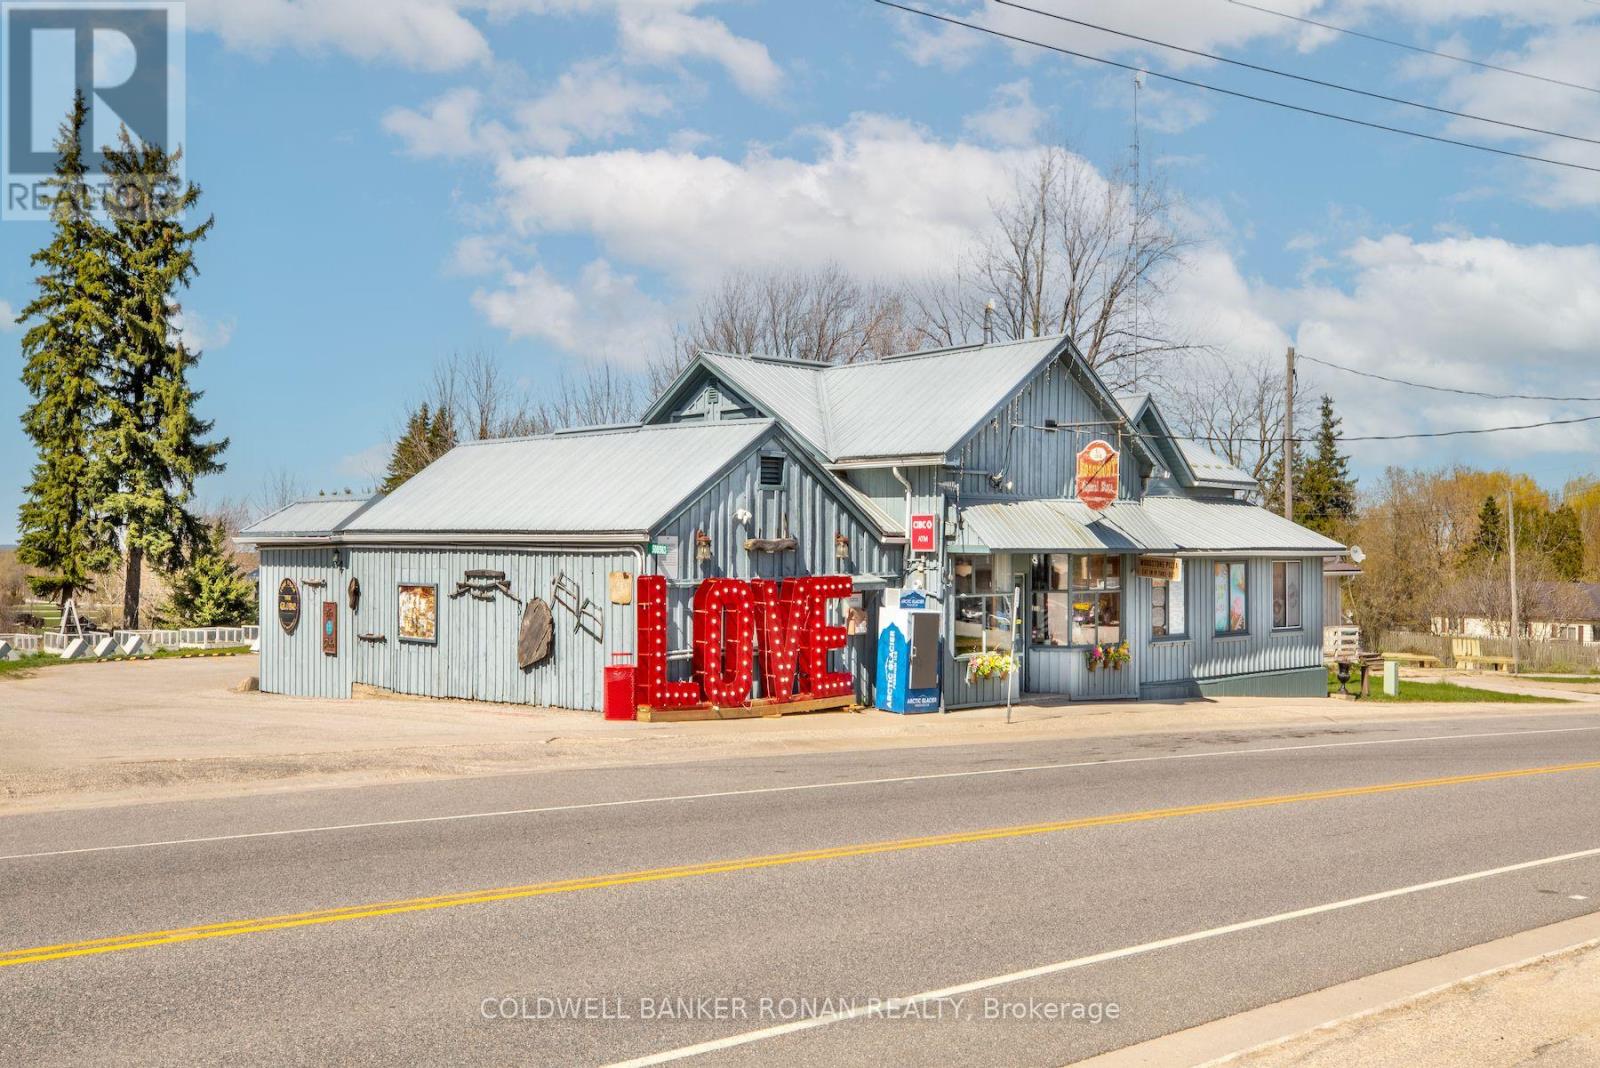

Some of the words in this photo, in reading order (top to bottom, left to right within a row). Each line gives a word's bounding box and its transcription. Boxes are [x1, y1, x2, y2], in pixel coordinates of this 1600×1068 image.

[913, 521, 926, 529] CIBC
[917, 535, 929, 543] ATM
[637, 575, 853, 711] LOVE
[888, 630, 896, 671] GLACIER
[886, 673, 894, 708] ARCTIC
